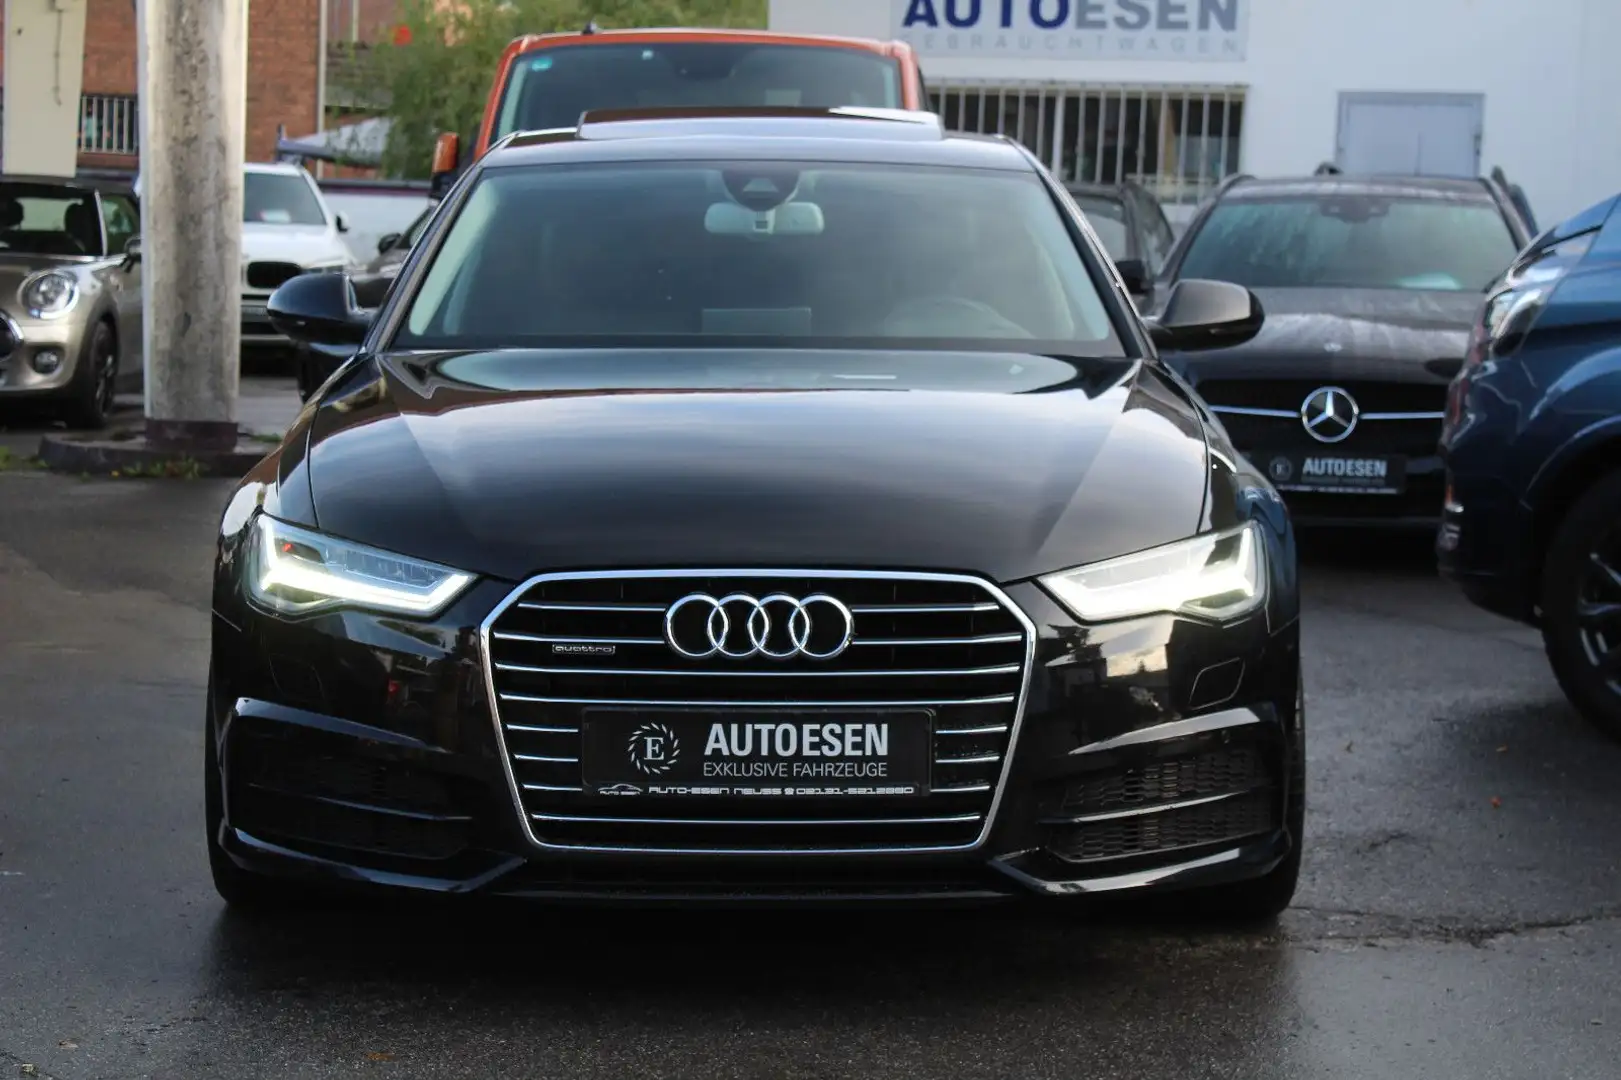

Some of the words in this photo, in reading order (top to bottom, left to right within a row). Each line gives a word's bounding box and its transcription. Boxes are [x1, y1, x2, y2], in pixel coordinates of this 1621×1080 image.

[555, 645, 612, 653] quattro
[643, 736, 665, 761] E
[703, 762, 788, 778] EXKLUSIVE
[792, 762, 888, 778] FAHRZEUGE
